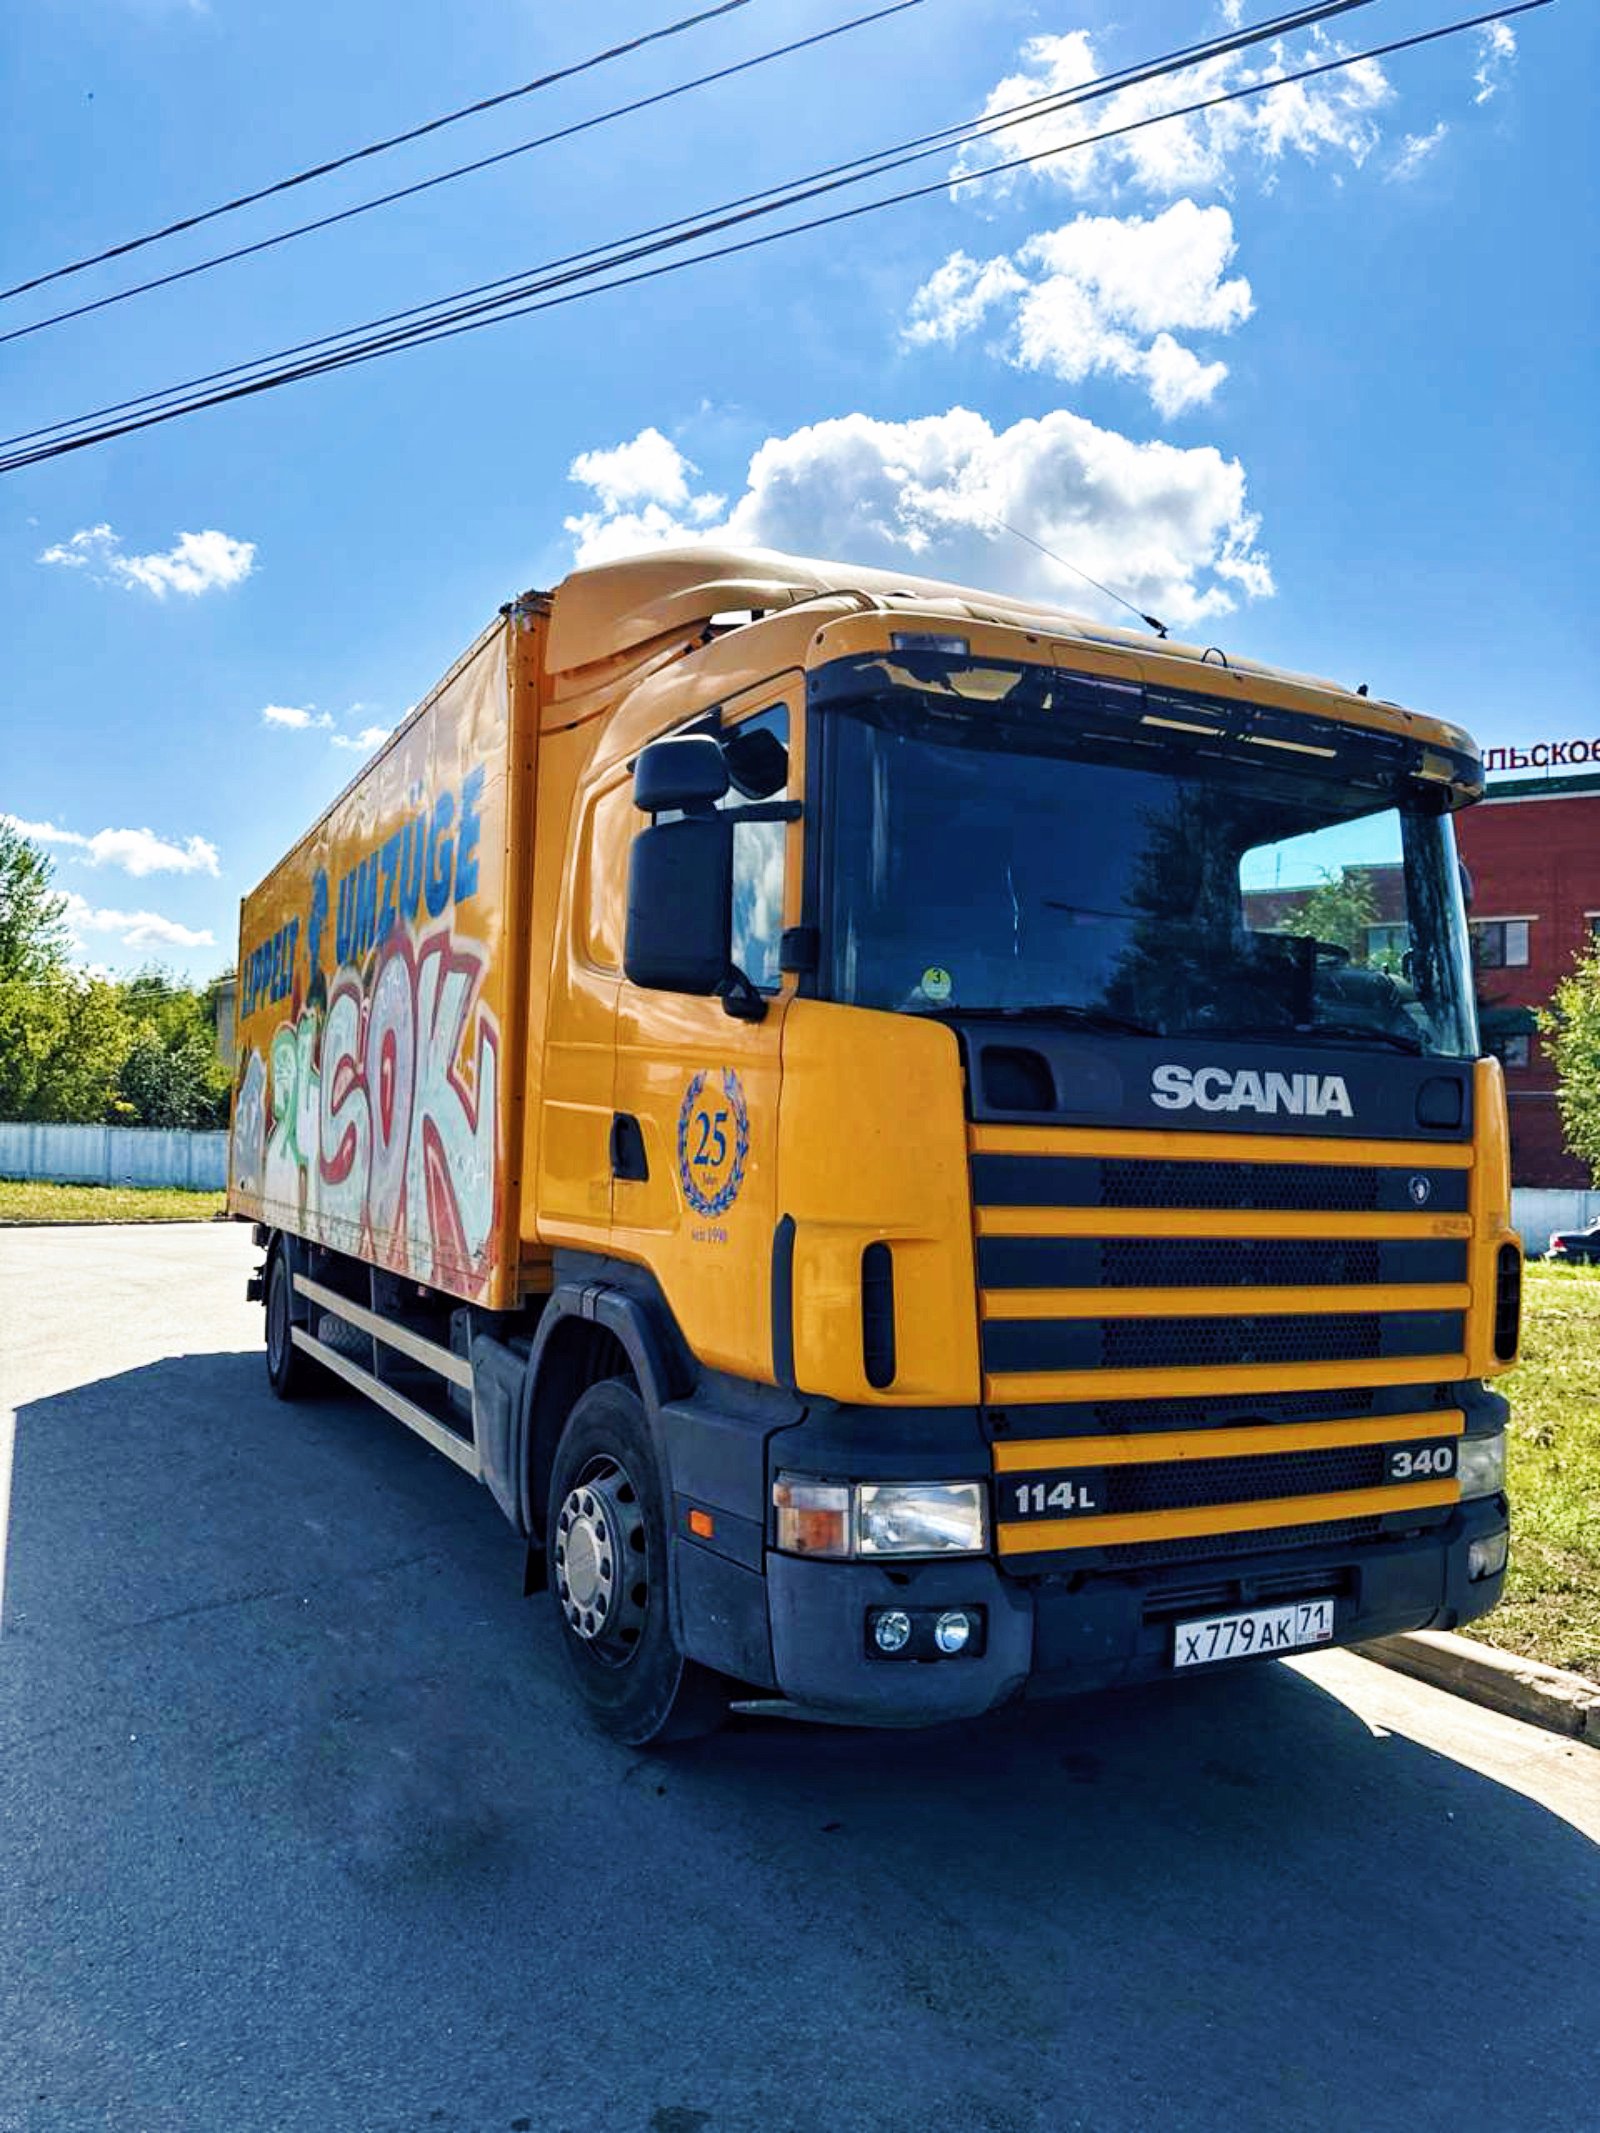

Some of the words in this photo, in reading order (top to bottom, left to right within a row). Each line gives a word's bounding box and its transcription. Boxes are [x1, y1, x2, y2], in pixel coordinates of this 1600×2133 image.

[336, 763, 485, 966] UMZÜGE
[1150, 1064, 1354, 1117] SCANIA
[694, 1111, 728, 1166] 25
[1391, 1447, 1453, 1477] 340
[1300, 1605, 1324, 1632] 71
